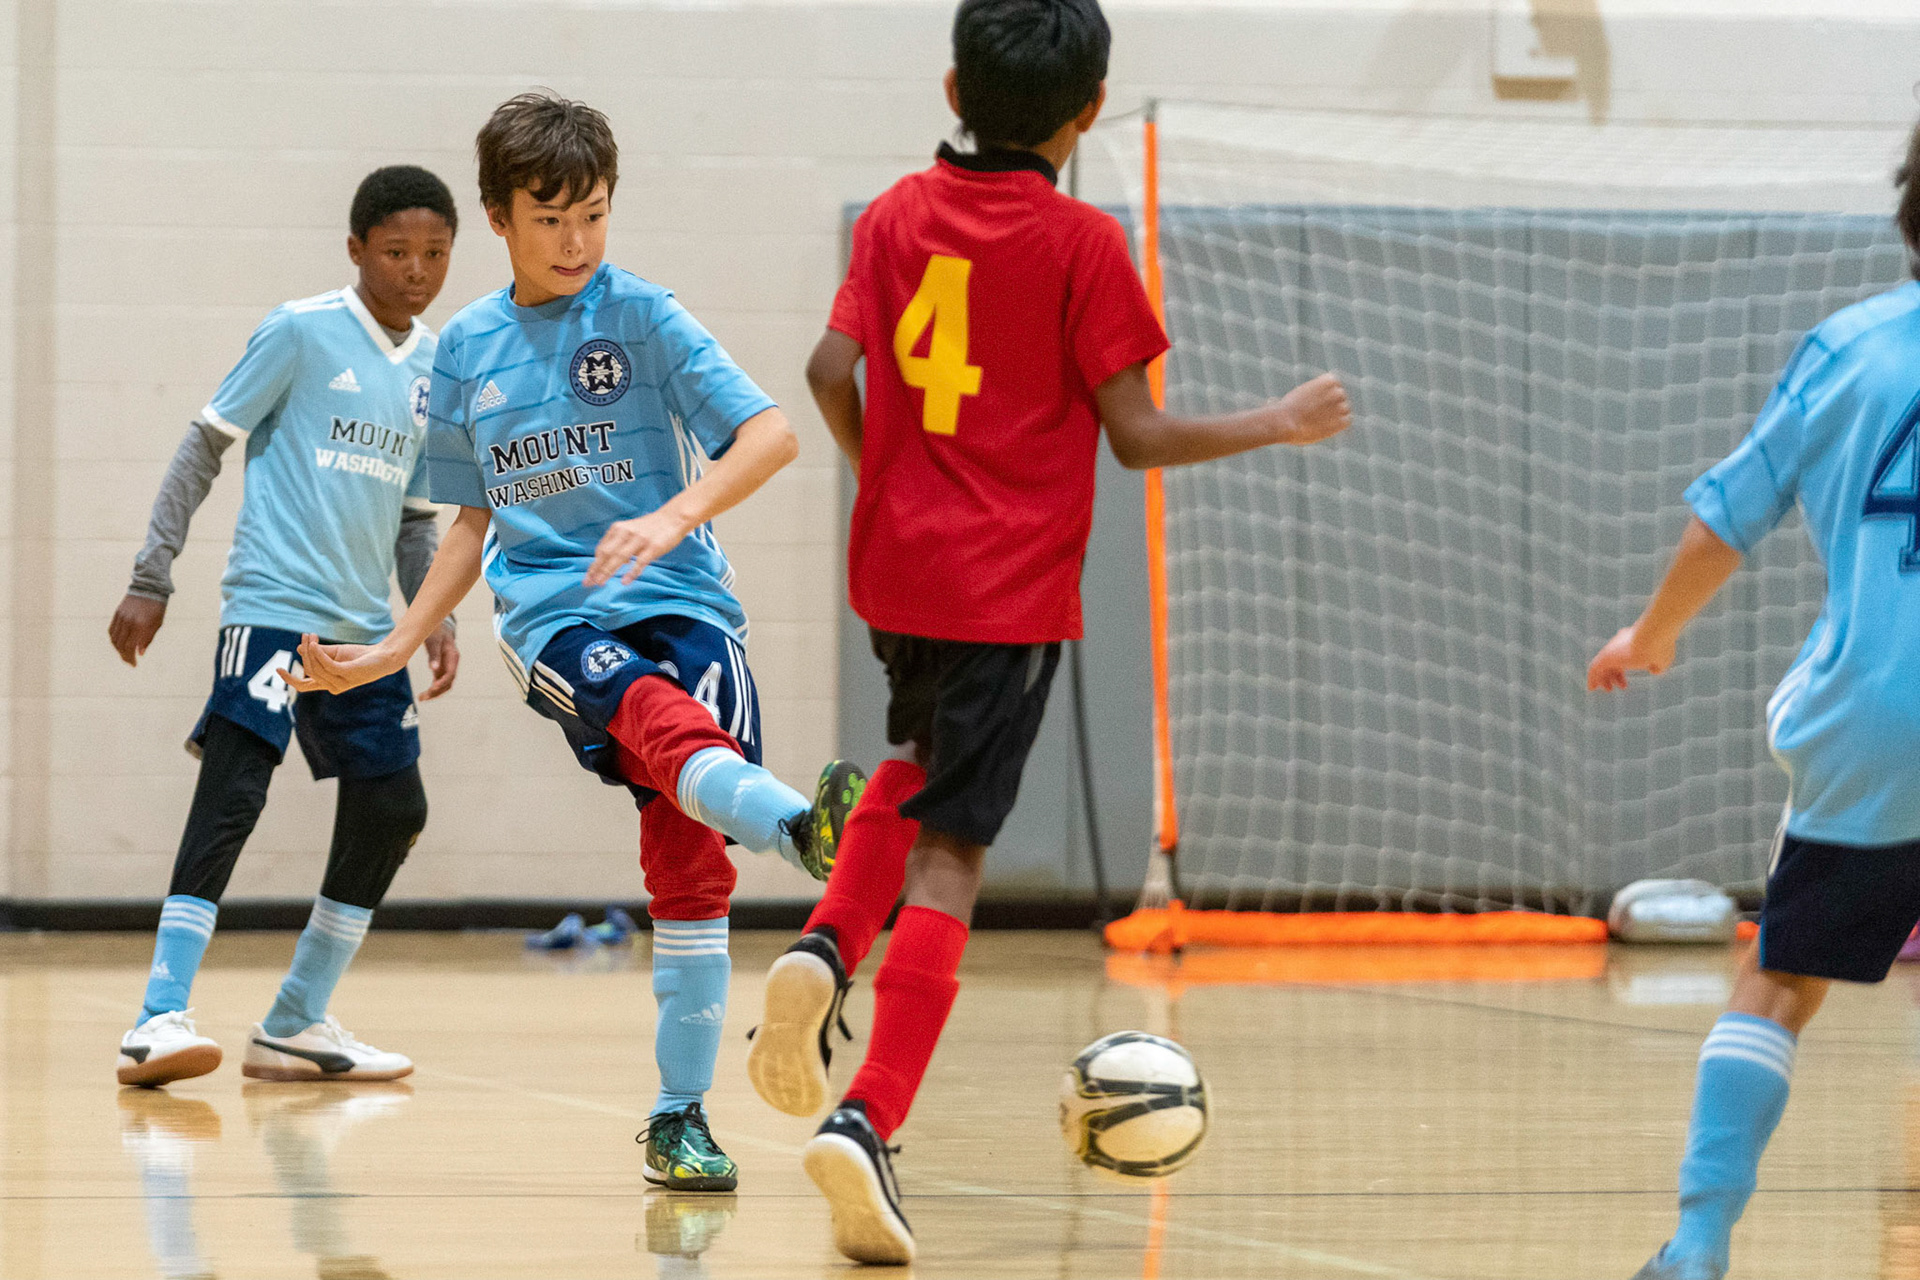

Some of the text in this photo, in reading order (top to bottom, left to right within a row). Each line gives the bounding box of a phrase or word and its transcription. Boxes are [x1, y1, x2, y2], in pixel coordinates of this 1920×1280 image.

[893, 254, 983, 436] 4
[329, 415, 413, 458] MOUN
[489, 420, 616, 476] MOUNT
[487, 459, 635, 509] WASHINGTON
